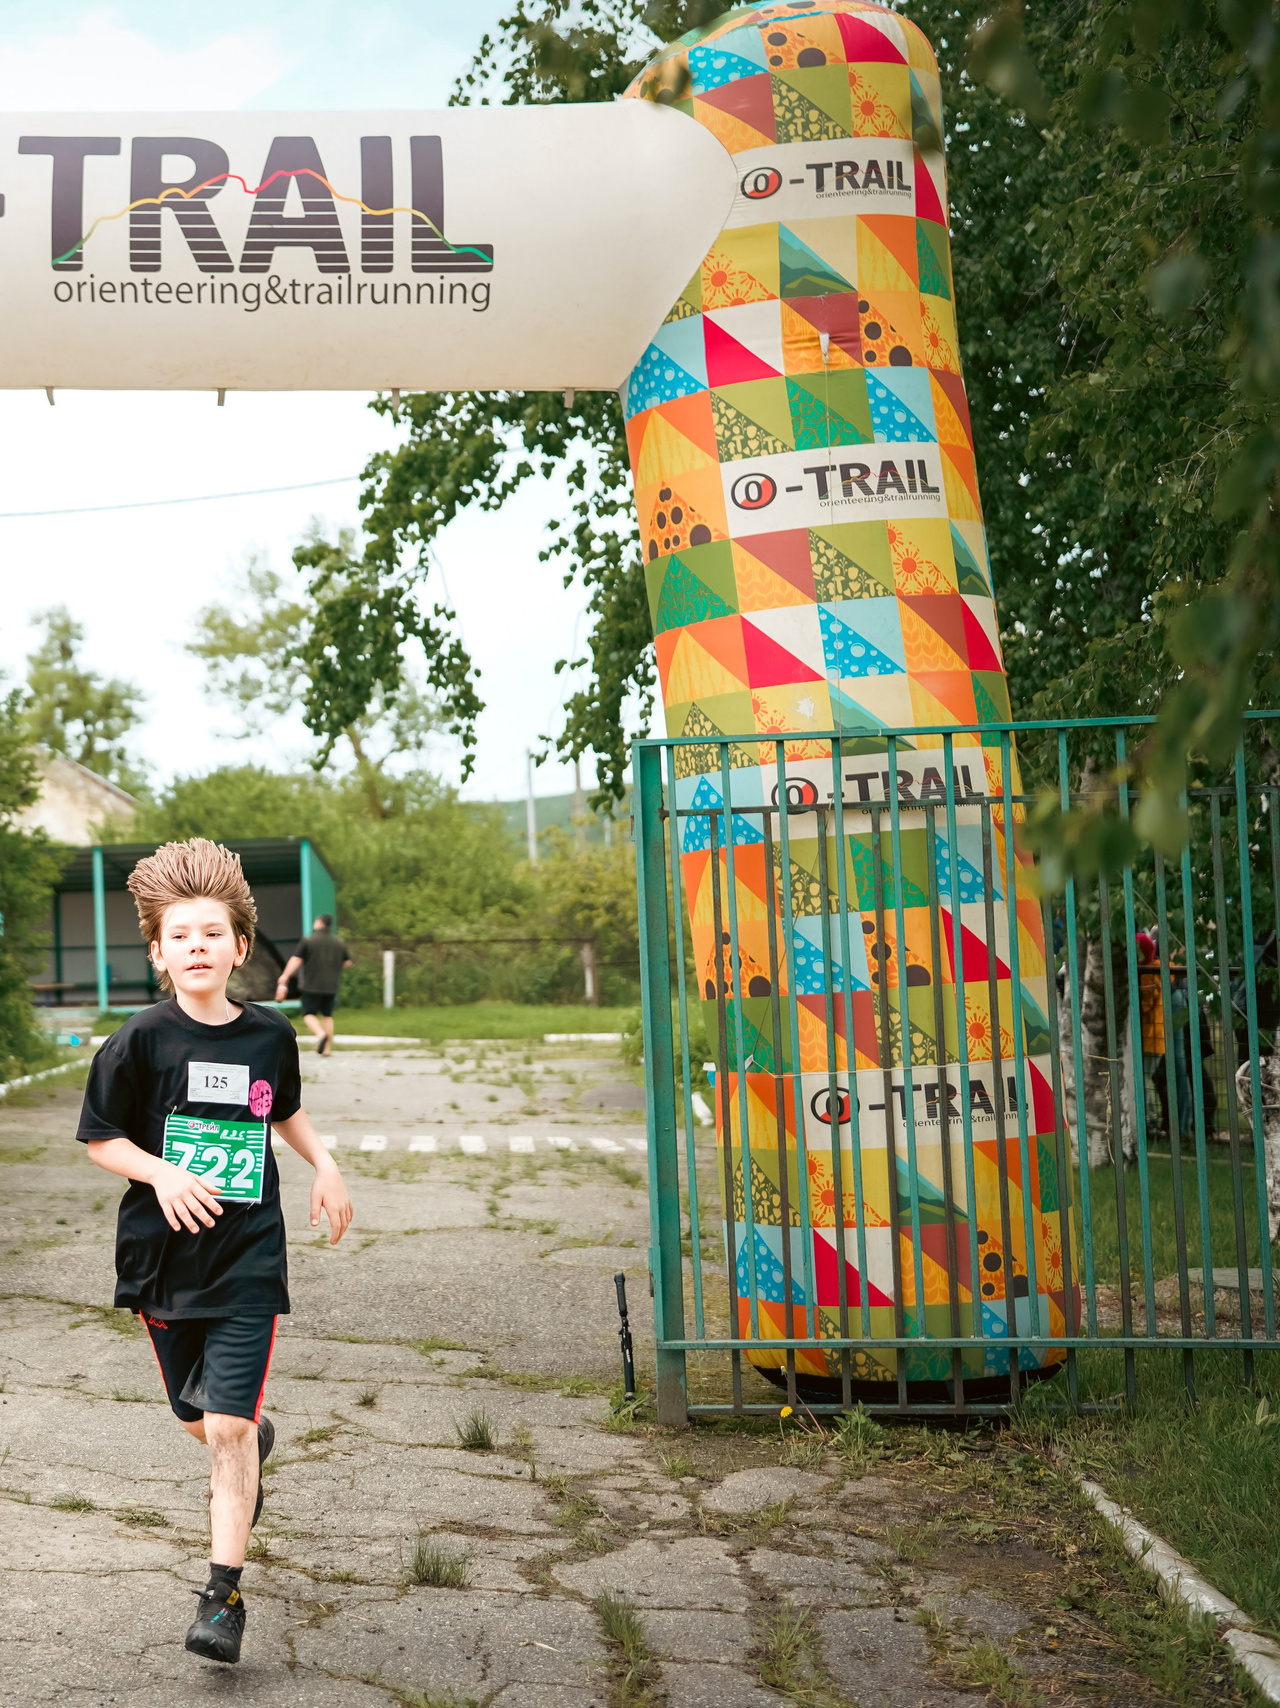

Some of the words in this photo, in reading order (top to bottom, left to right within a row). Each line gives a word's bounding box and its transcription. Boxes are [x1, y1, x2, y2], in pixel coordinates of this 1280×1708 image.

[815, 188, 912, 199] orienteering&trailrunning
[52, 276, 492, 312] orienteering&trailrunning
[819, 492, 941, 508] orienteering&trailrunning
[204, 1075, 228, 1089] 125
[810, 1076, 1029, 1125] O-TRAL
[171, 1141, 255, 1189] 722
